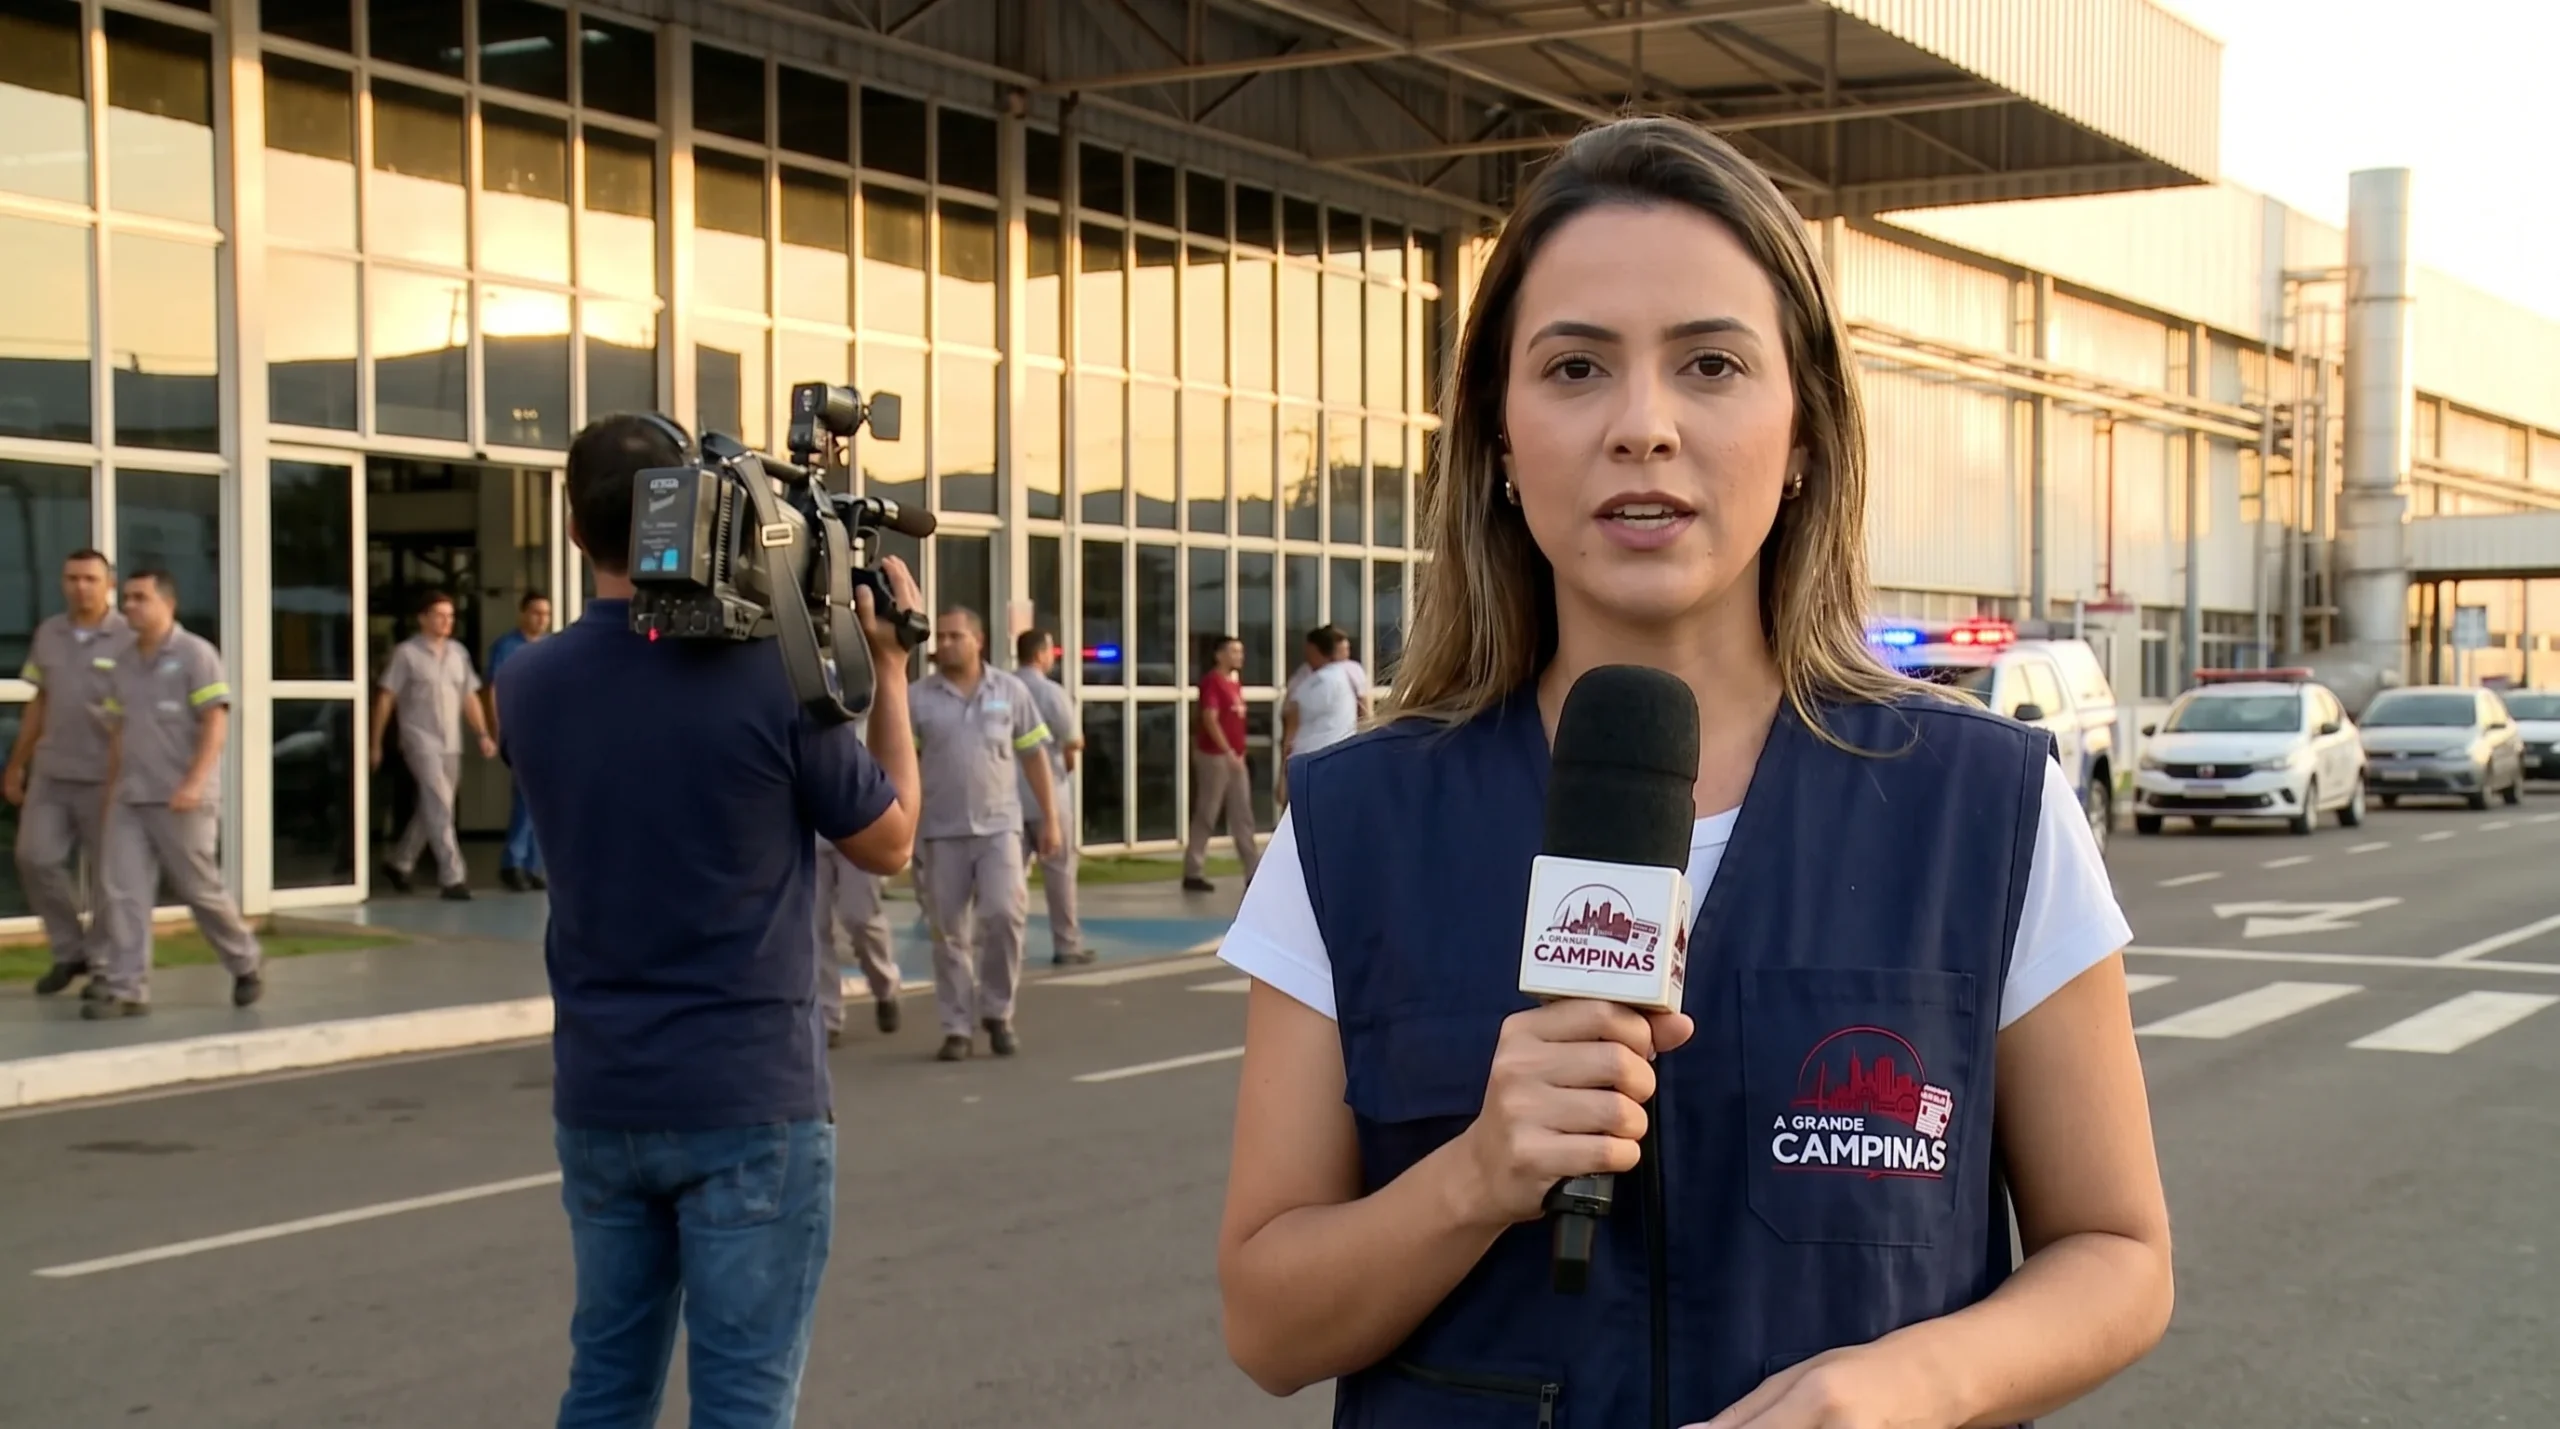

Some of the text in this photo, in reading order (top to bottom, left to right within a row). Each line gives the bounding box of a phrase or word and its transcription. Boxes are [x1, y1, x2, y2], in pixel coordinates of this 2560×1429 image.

[1537, 934, 1544, 942] A
[1535, 945, 1654, 971] CAMPINAS
[1774, 1116, 1864, 1131] A GRANDE
[1772, 1133, 1946, 1170] CAMPINAS
